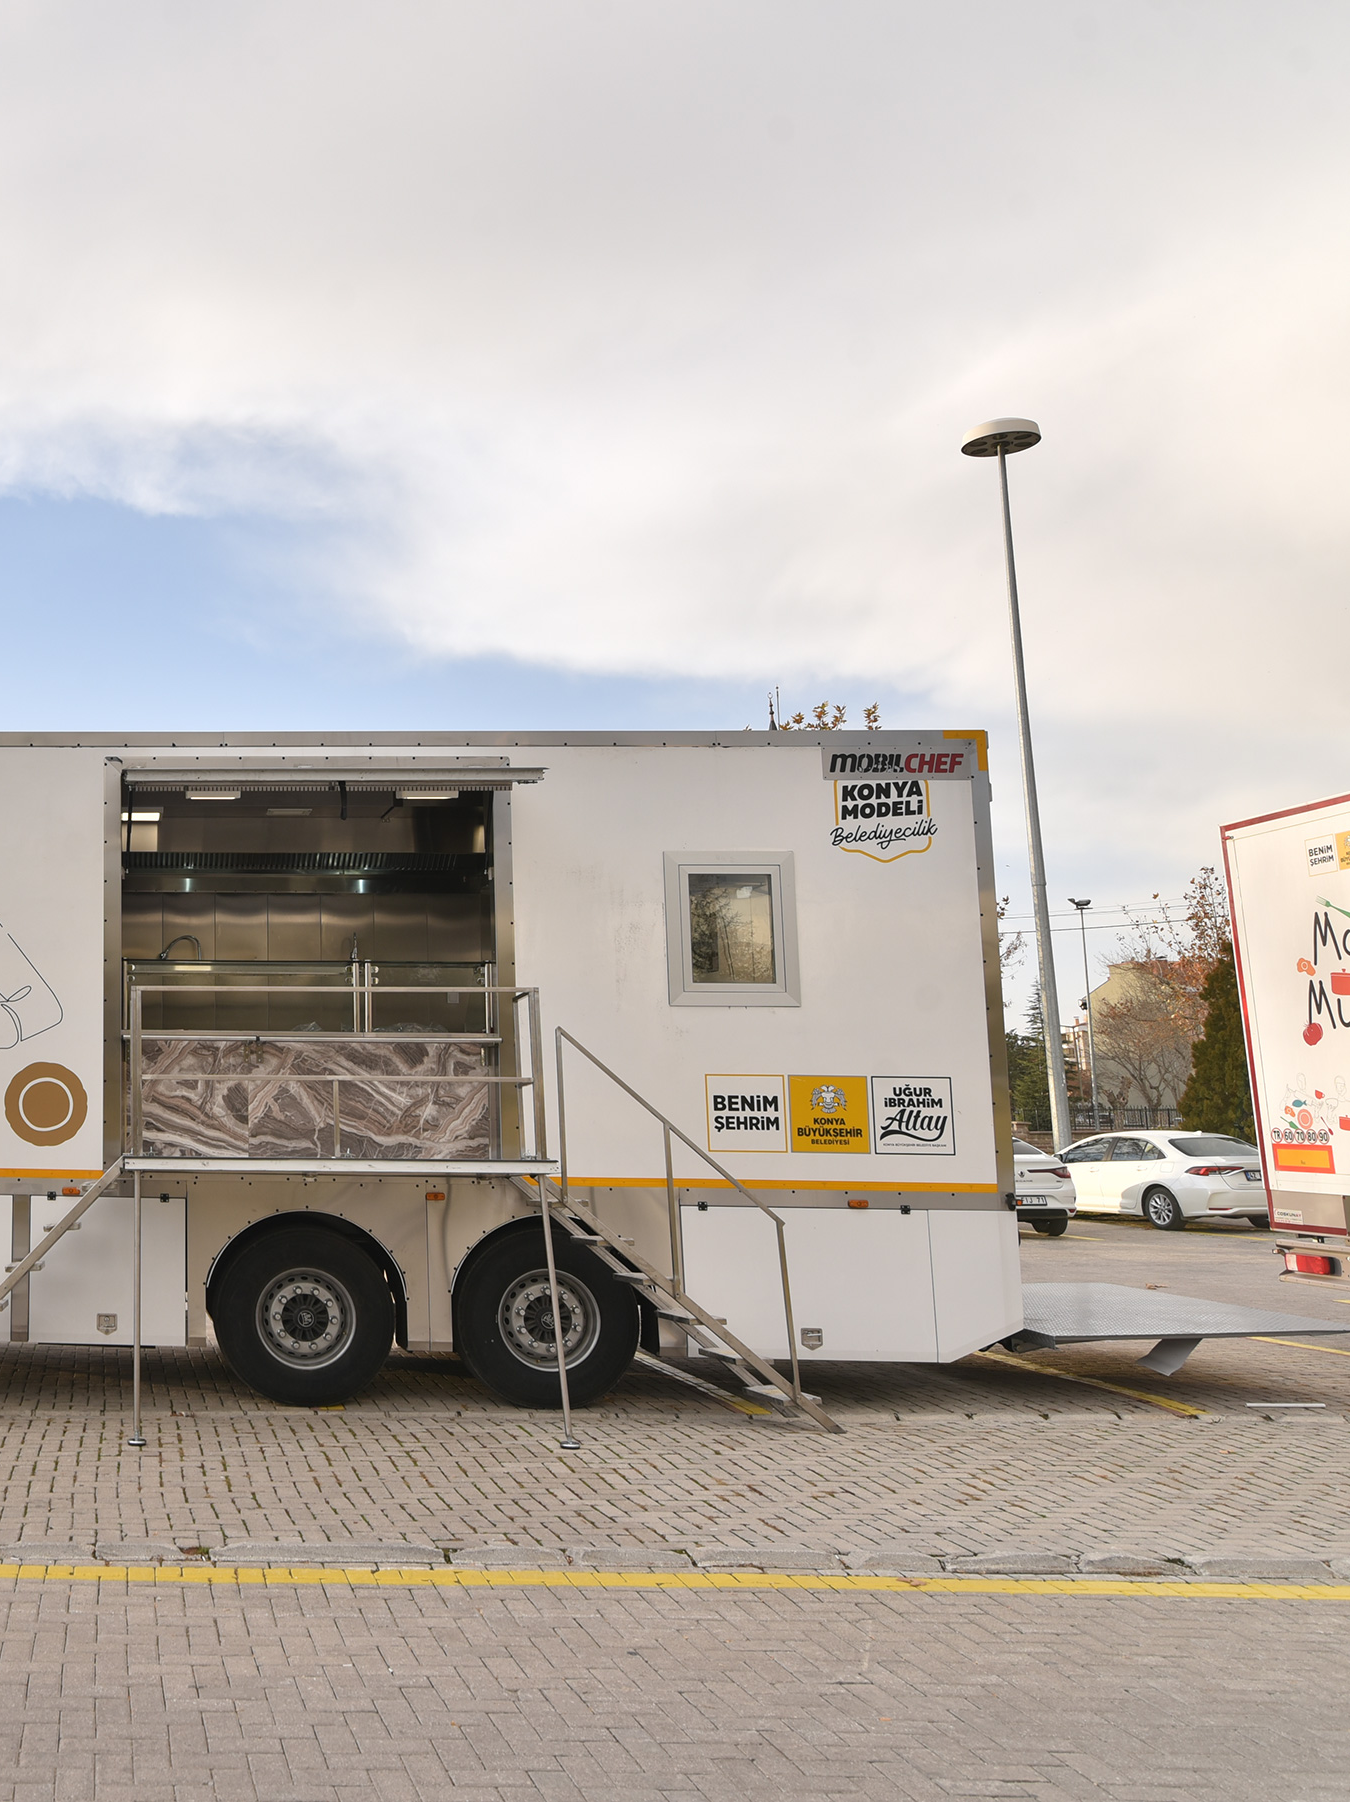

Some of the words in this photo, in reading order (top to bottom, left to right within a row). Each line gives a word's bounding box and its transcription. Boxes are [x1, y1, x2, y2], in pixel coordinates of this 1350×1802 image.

[841, 780, 923, 802] KONYA
[830, 818, 938, 850] Belediyecilik
[892, 1083, 933, 1098] UĞUR
[813, 1117, 846, 1126] KONYA
[879, 1108, 948, 1142] Altay
[797, 1125, 863, 1139] BÜYÜKŞEHİR
[1273, 1130, 1281, 1140] TR
[1285, 1131, 1293, 1140] 60
[1296, 1131, 1304, 1141] 70
[1307, 1131, 1316, 1141] 80
[1318, 1132, 1327, 1142] 90
[811, 1138, 850, 1146] BELEDİYESİ
